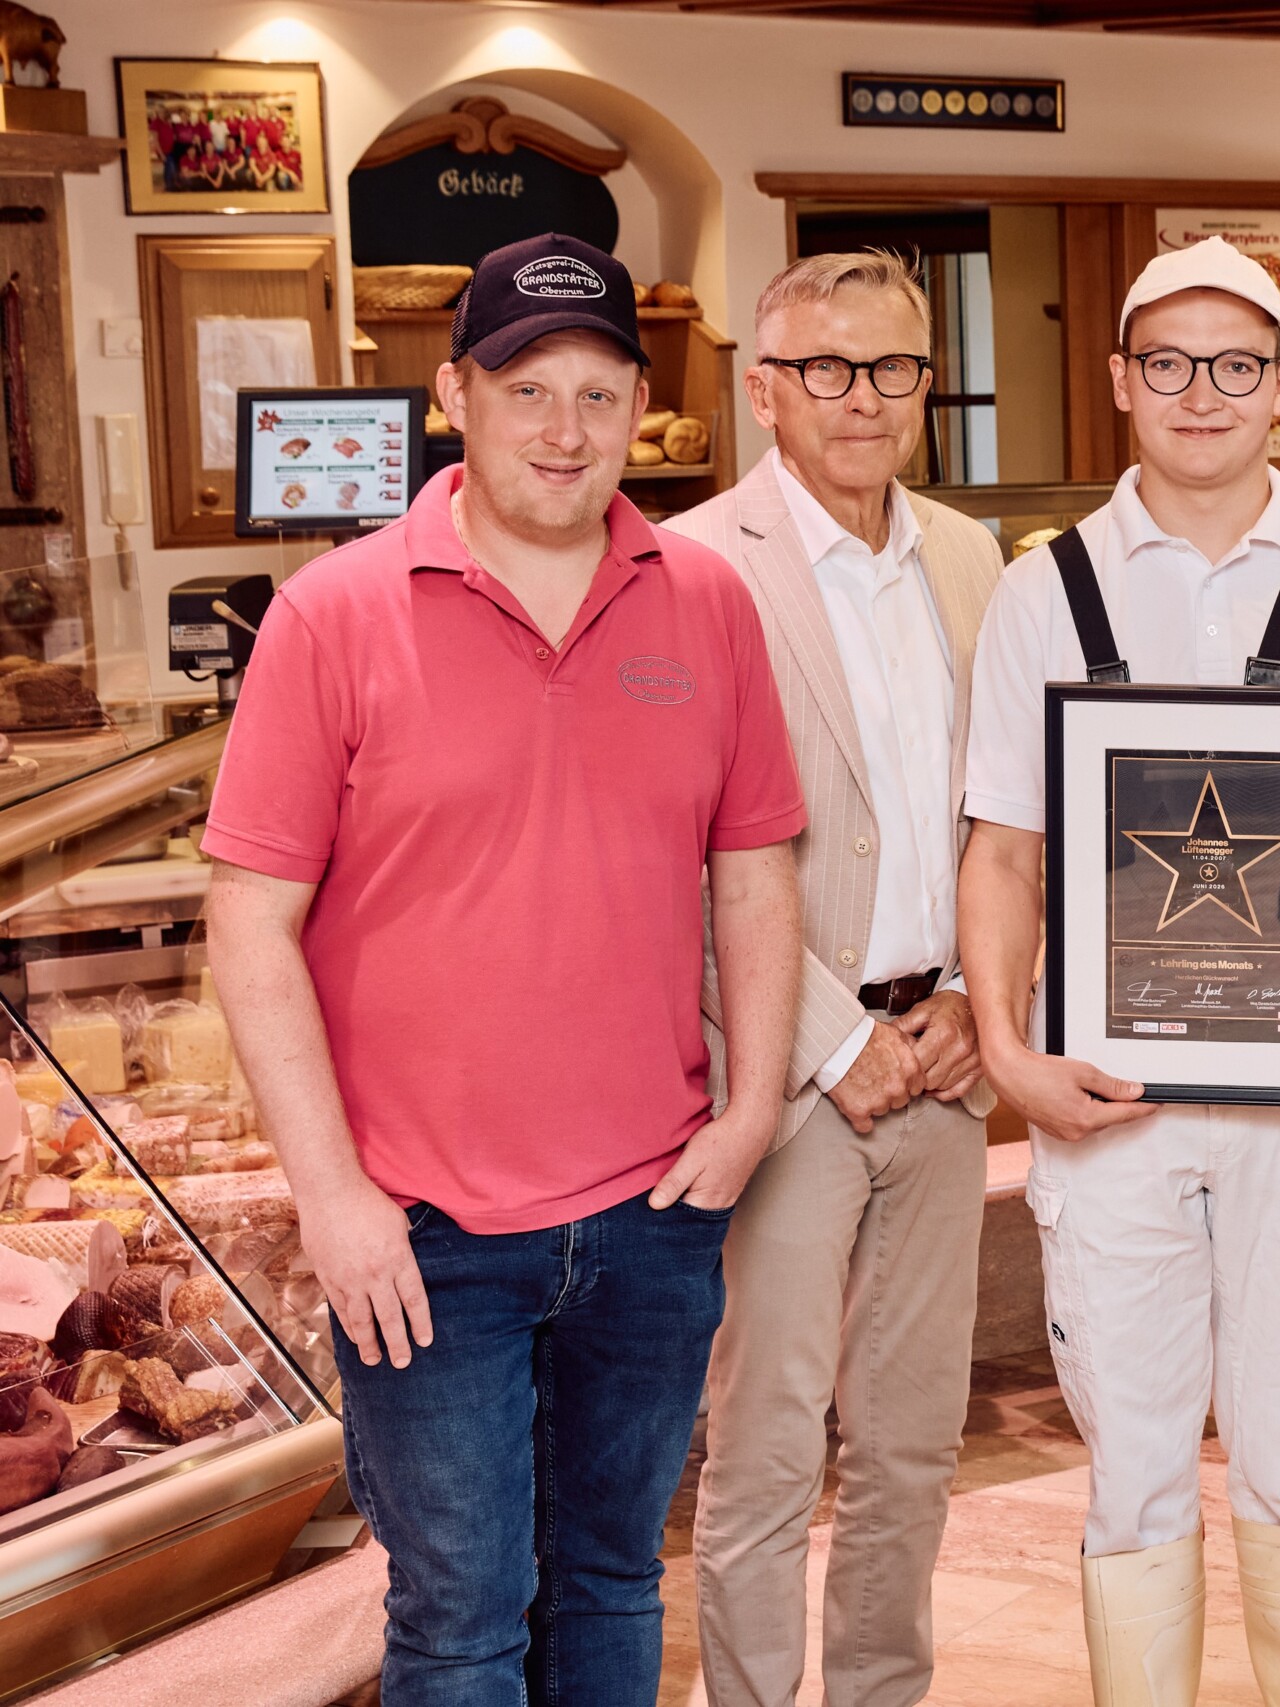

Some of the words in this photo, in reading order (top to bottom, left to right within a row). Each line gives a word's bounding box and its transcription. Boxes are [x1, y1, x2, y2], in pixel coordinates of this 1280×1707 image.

[438, 167, 524, 198] Gebäck
[521, 273, 601, 290] BRANDSTÄTTER
[539, 286, 585, 296] Obertrum
[1187, 838, 1229, 847] Johannes
[1181, 845, 1234, 856] Lüftenegger
[1160, 959, 1199, 970] Lehrling
[1199, 959, 1217, 969] des
[1217, 960, 1254, 970] Monats
